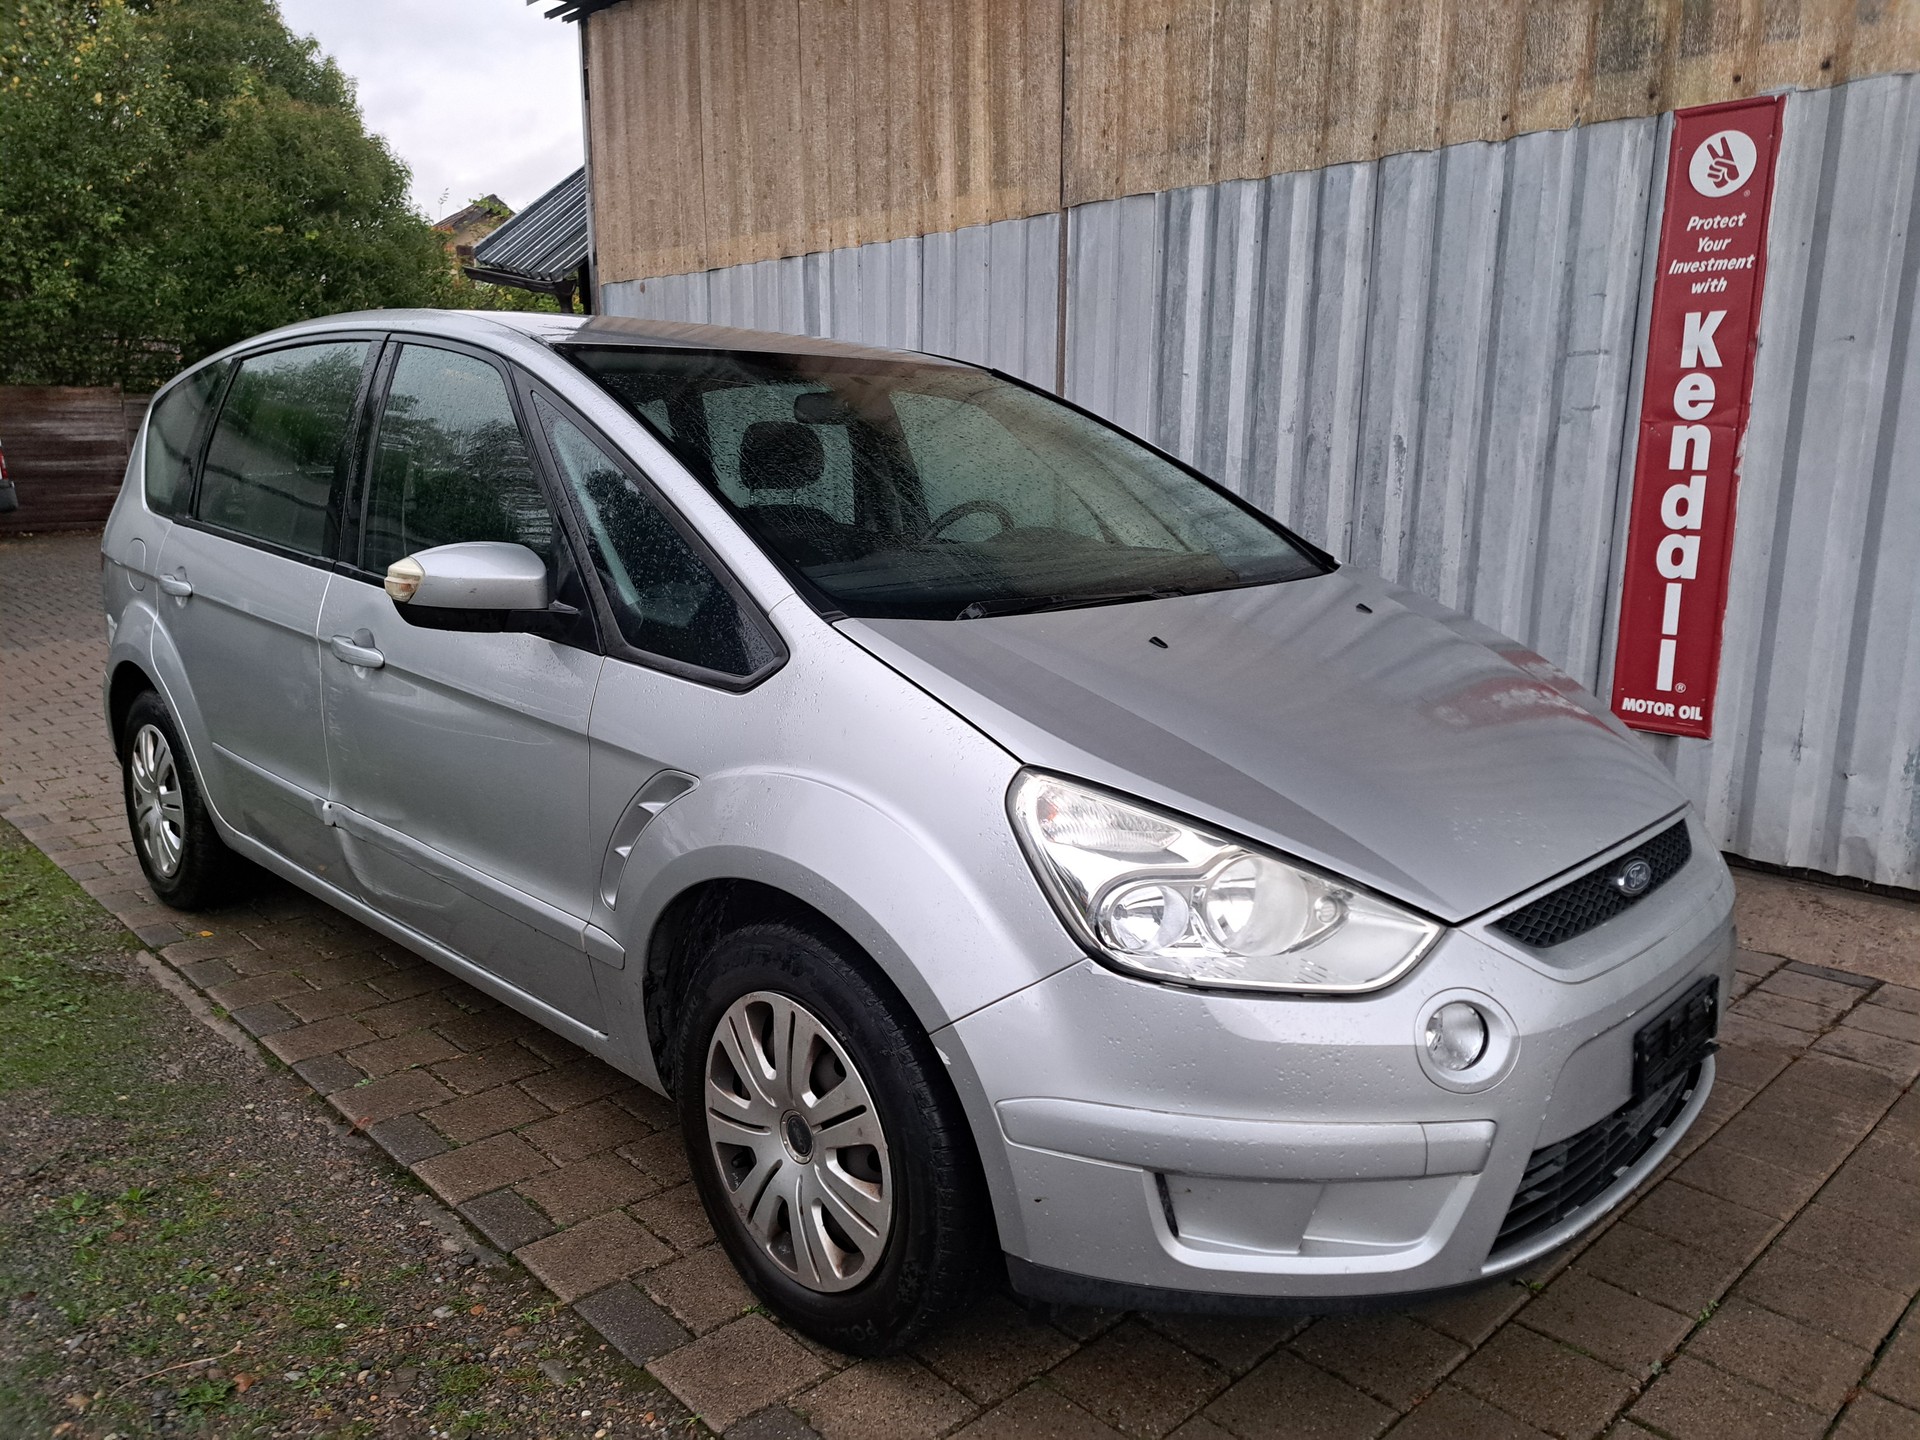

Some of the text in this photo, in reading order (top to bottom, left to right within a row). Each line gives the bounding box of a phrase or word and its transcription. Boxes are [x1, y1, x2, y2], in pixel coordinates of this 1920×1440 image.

[1686, 212, 1747, 231] Protect
[1697, 237, 1732, 253] Your
[1668, 253, 1755, 275] Investment
[1691, 277, 1727, 294] with
[1656, 310, 1727, 691] Kendall
[1622, 698, 1703, 721] MOTOR OIL
